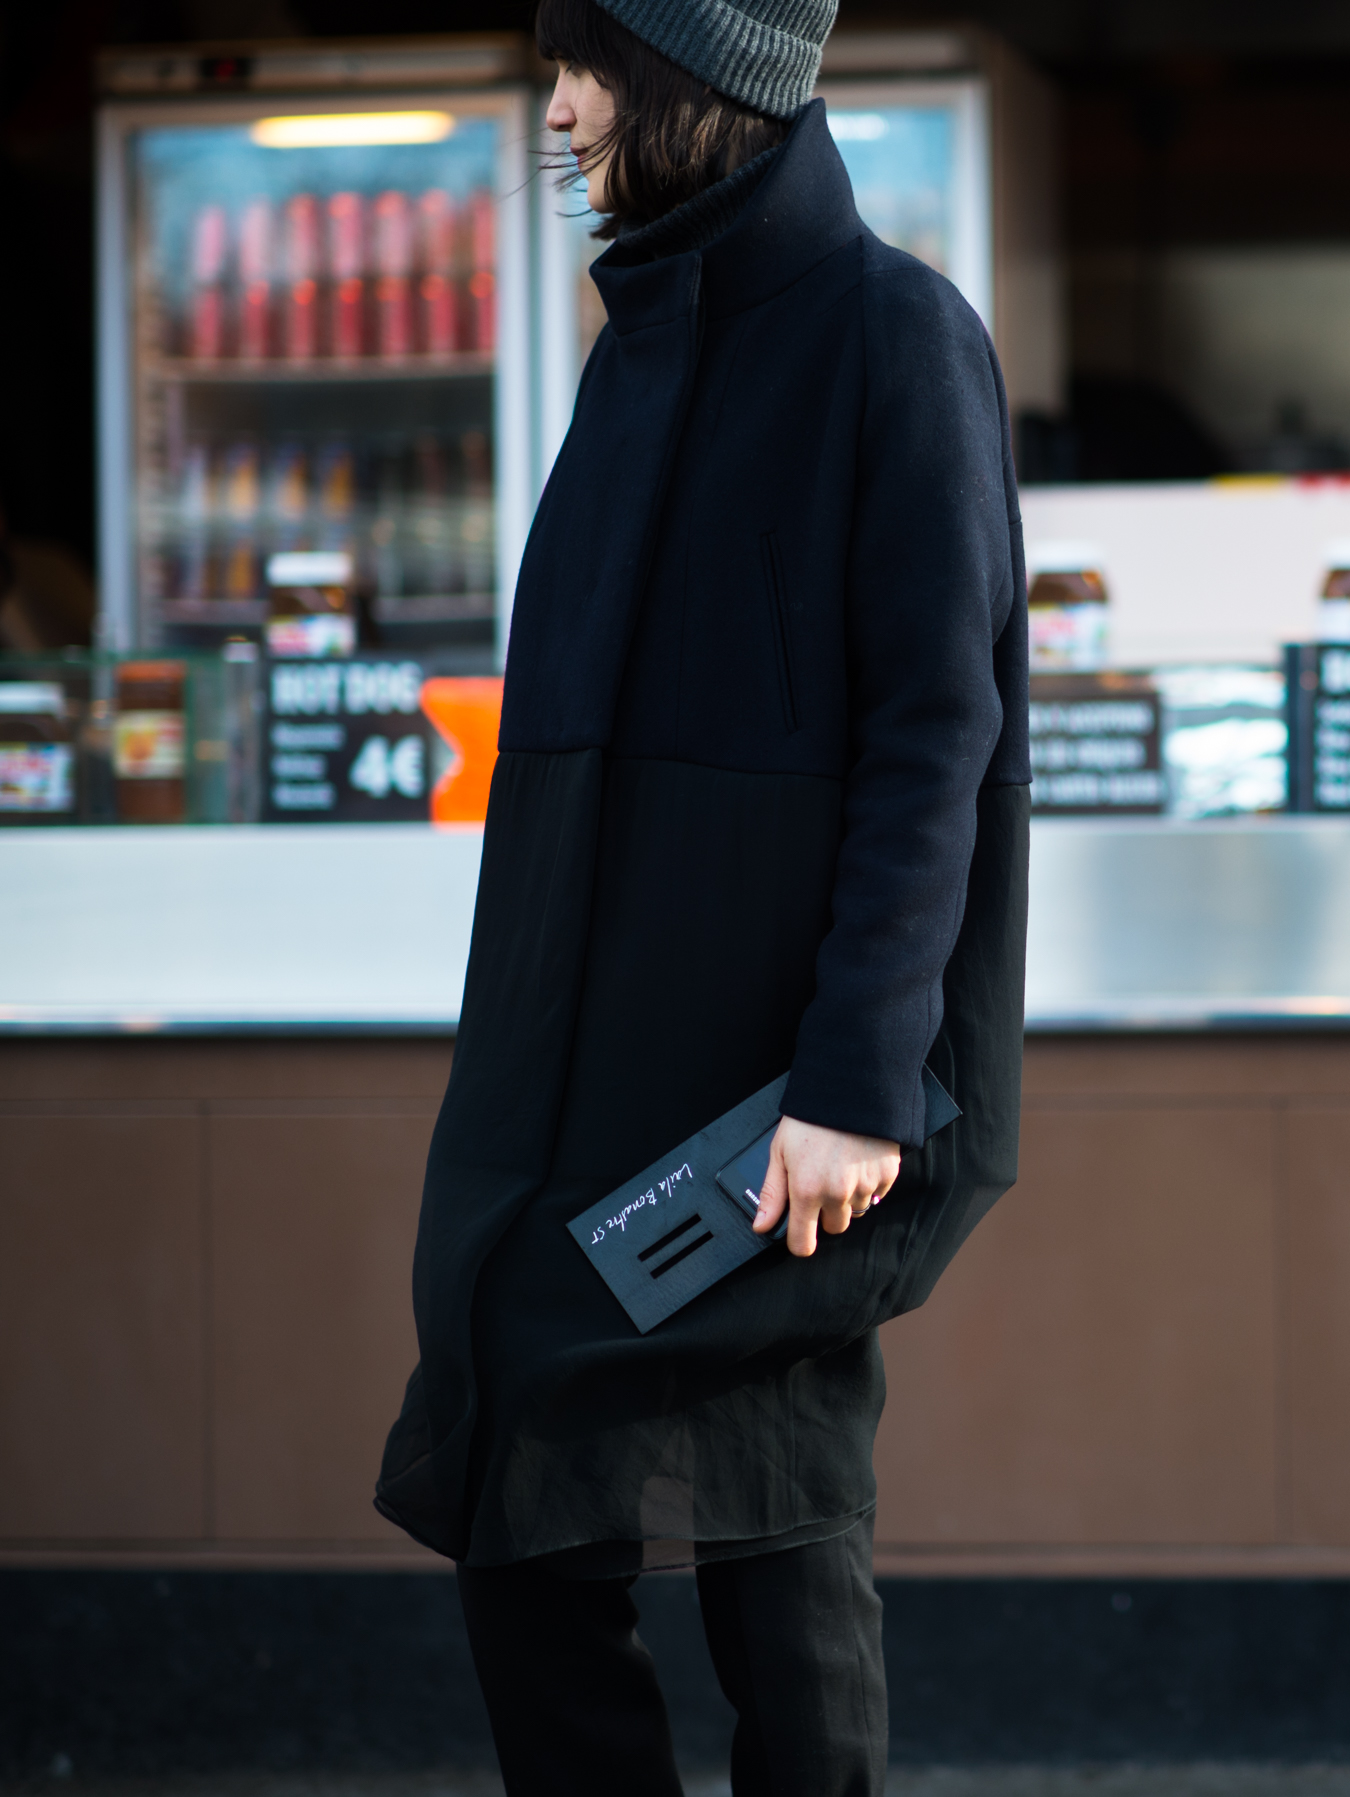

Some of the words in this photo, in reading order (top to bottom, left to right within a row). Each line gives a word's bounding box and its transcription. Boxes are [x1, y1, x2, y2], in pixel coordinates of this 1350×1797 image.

[272, 663, 339, 715] HOT
[345, 661, 422, 715] DOG
[350, 734, 424, 798] 4€
[658, 1163, 693, 1198] Laila
[605, 1187, 658, 1232] Bonastre
